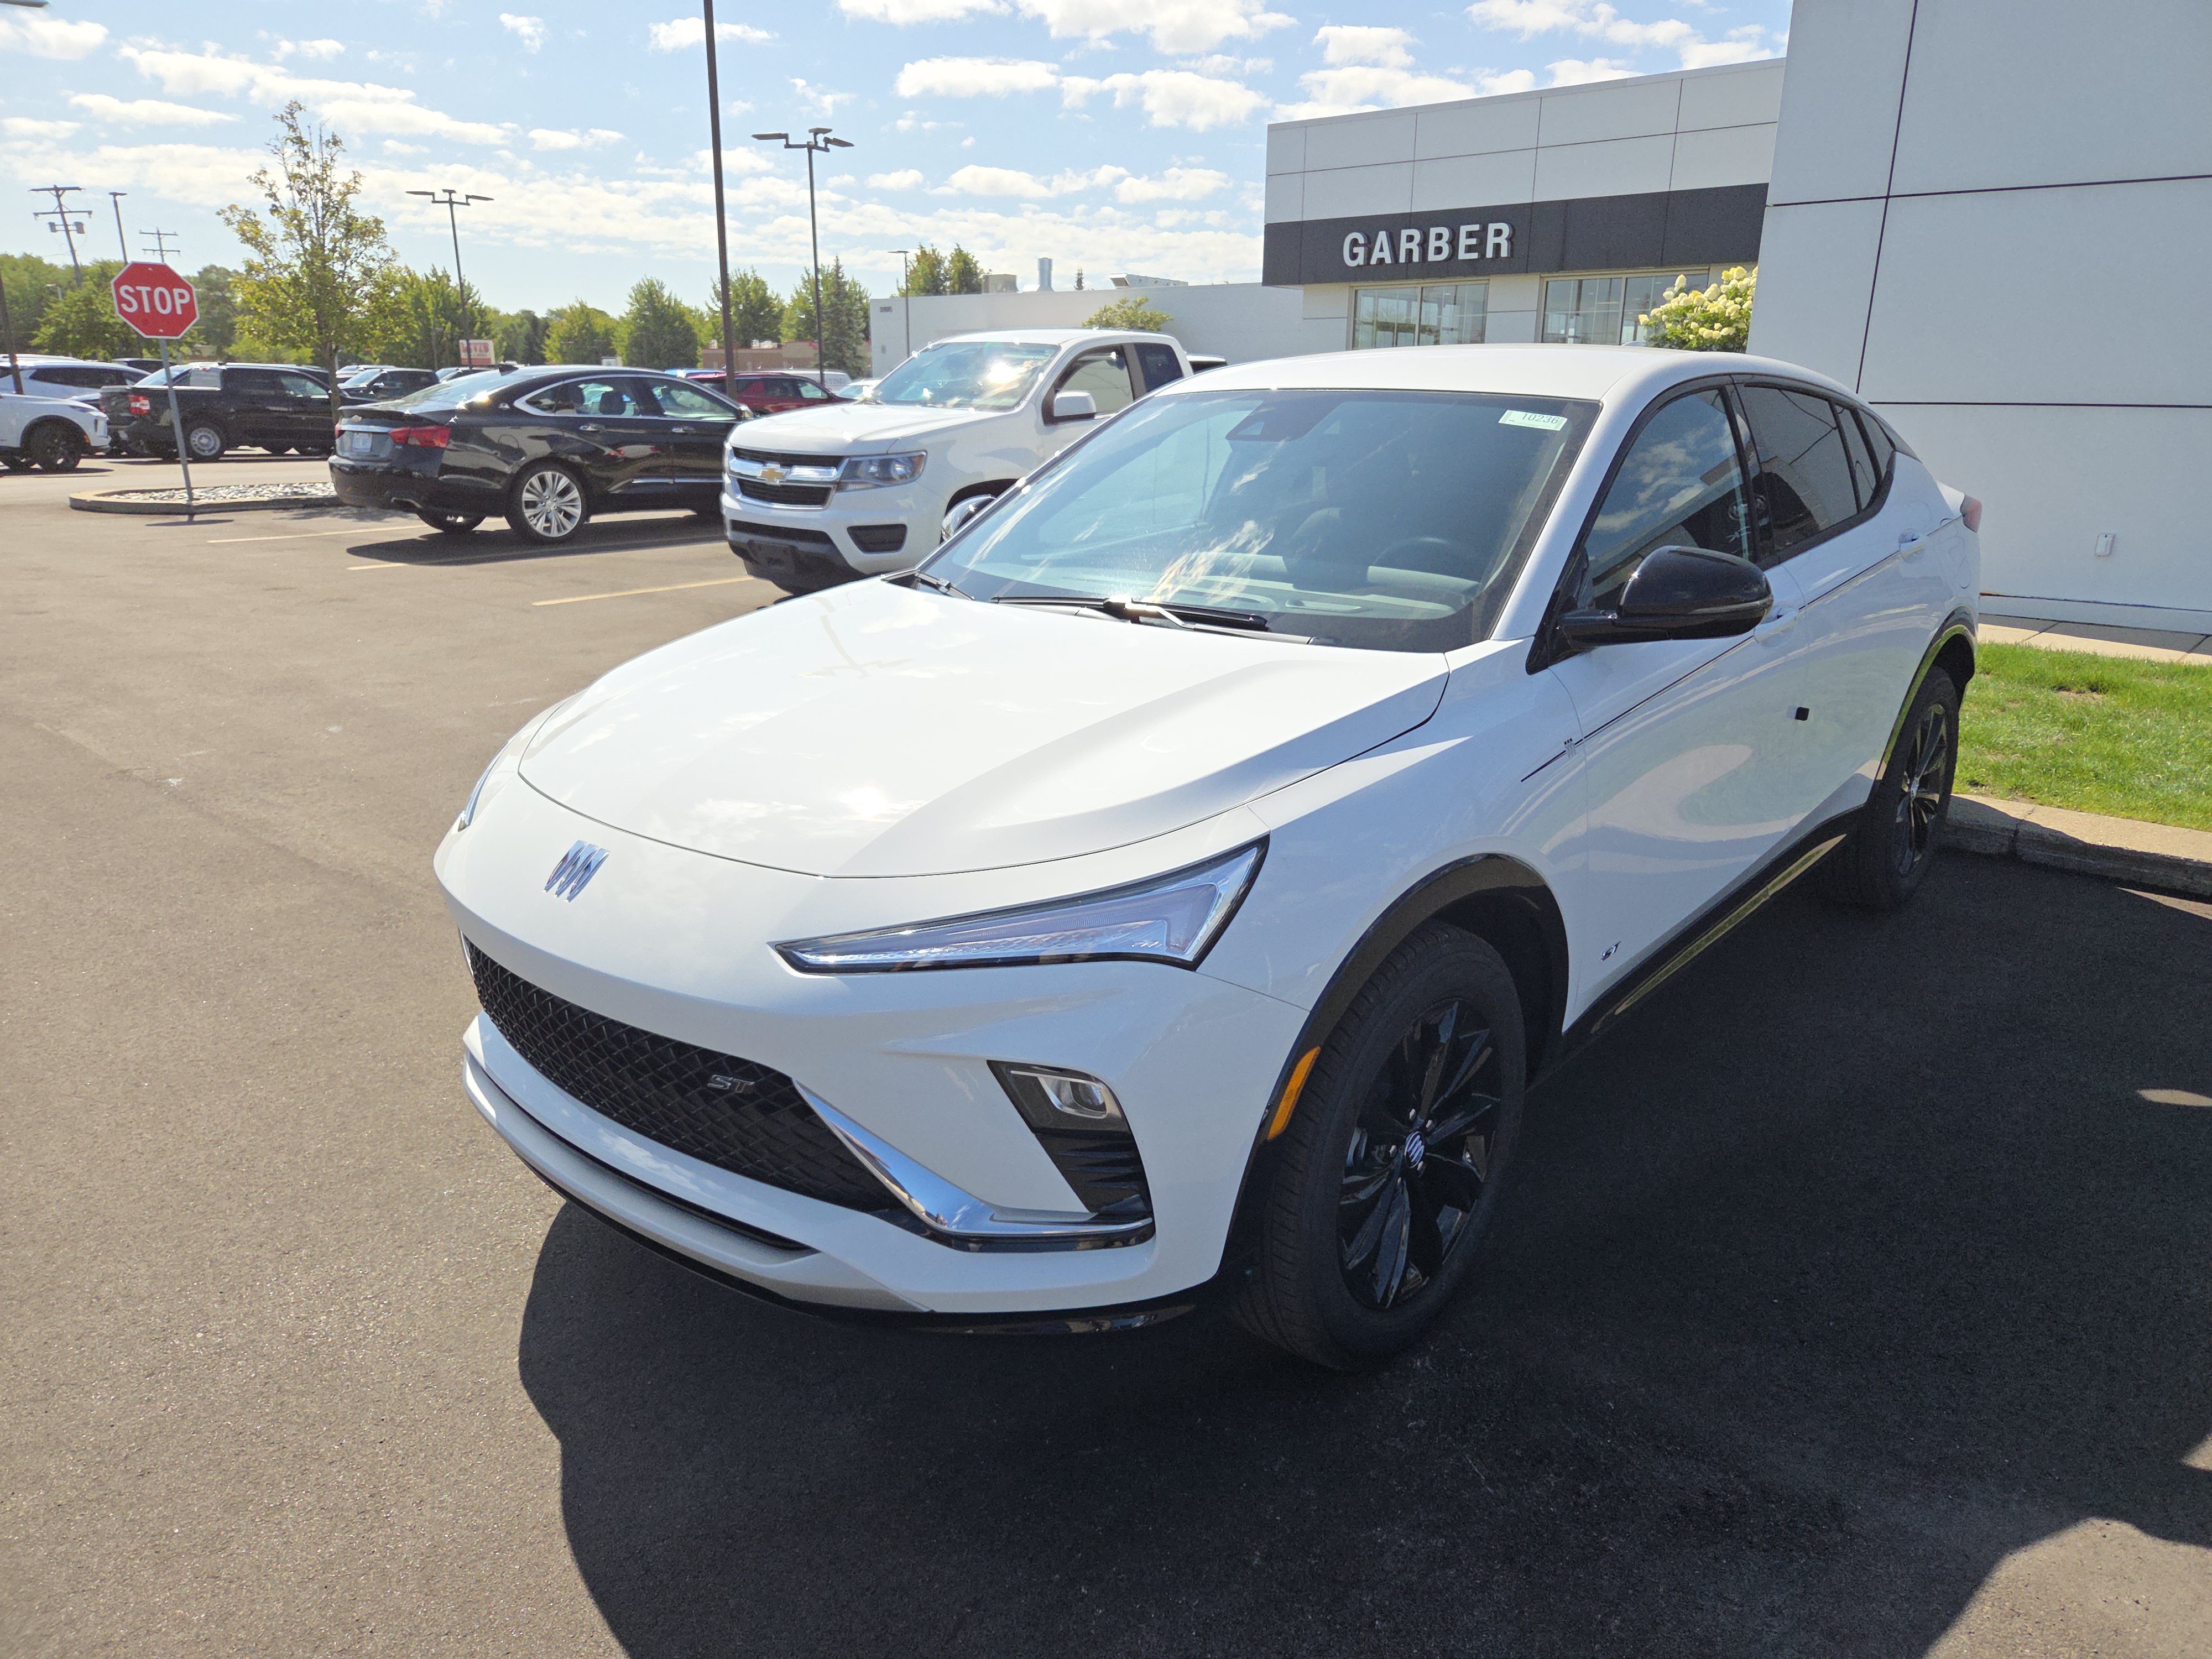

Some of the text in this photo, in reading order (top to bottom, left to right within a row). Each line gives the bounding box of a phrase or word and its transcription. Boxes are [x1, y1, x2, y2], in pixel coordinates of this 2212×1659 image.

[1343, 222, 1511, 267] GARBER
[119, 285, 190, 315] STOP
[1522, 413, 1560, 424] 10236
[707, 1074, 755, 1093] ST
